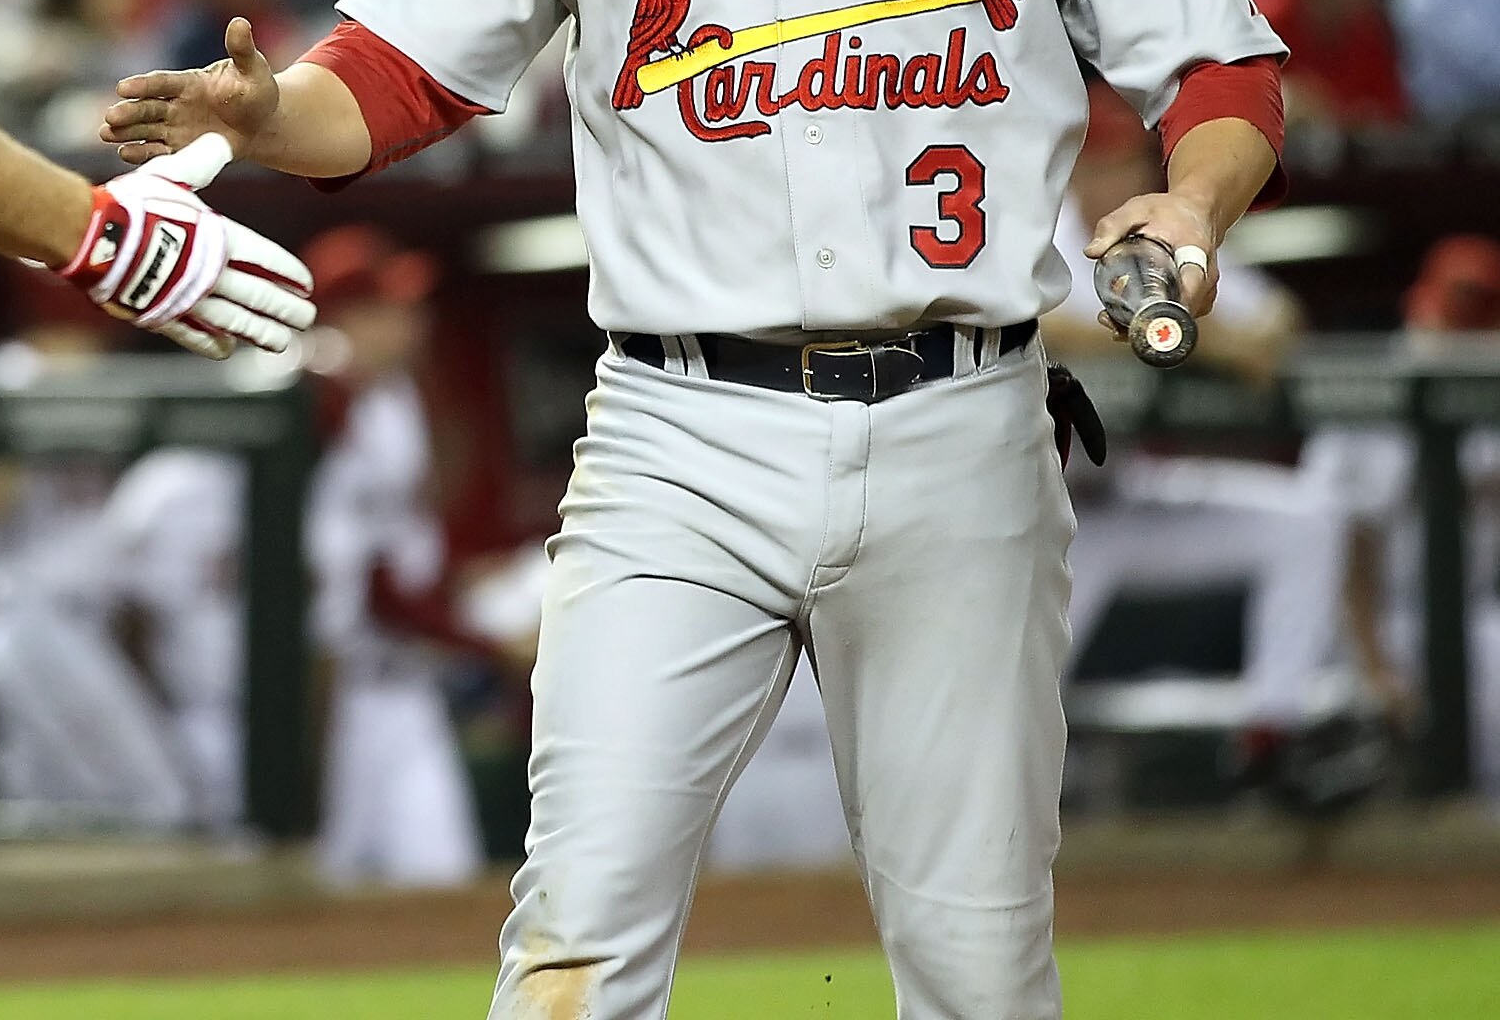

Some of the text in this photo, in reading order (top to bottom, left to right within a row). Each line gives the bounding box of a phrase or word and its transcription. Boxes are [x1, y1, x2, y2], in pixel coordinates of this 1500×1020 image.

[676, 23, 1011, 142] Cardinals
[129, 226, 181, 304] Frank
[905, 144, 986, 269] 3
